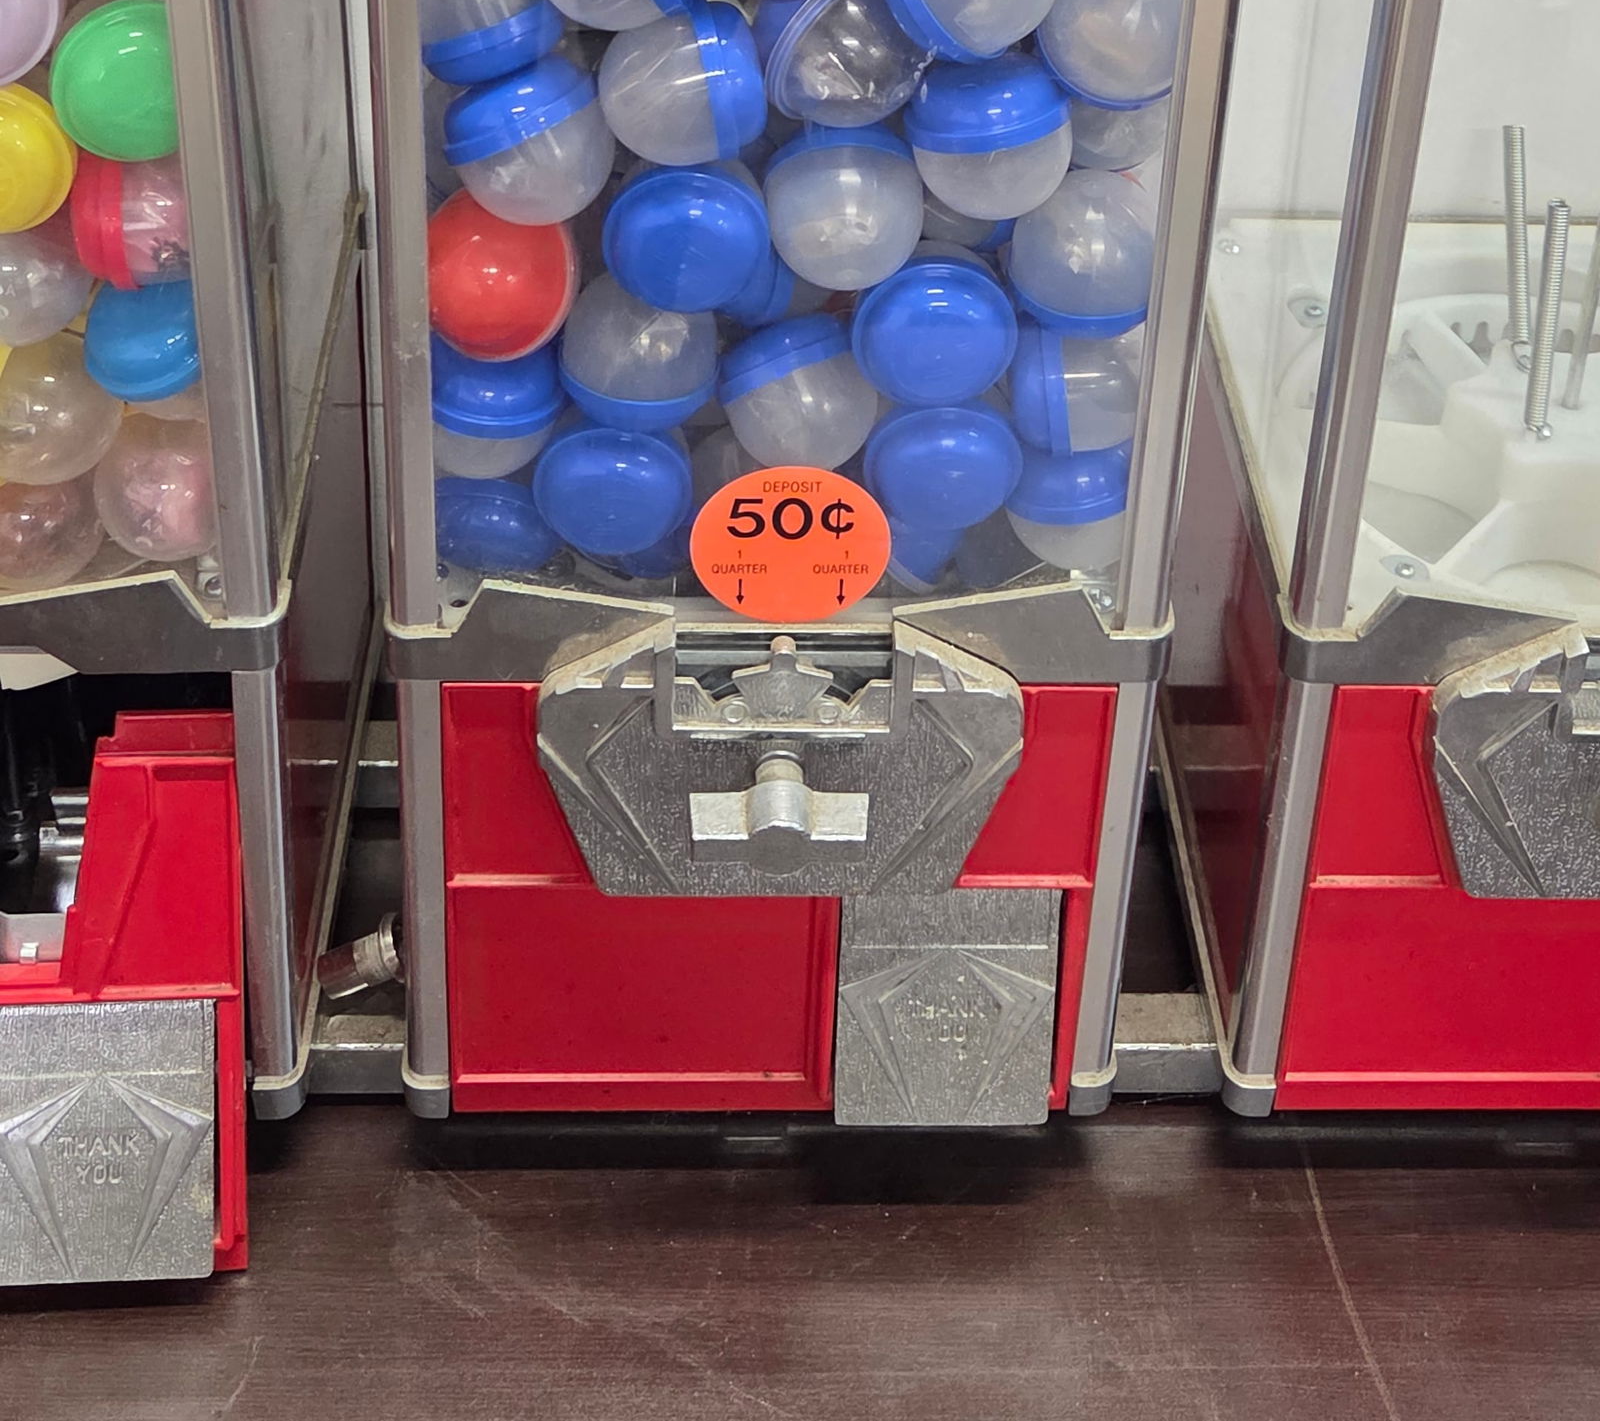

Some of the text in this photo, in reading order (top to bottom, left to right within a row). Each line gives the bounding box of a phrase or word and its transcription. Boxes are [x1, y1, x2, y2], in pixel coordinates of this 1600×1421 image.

[762, 481, 823, 493] DEPOSIT
[726, 497, 855, 540] 50¢
[737, 549, 743, 560] 1
[844, 549, 850, 560] 1
[711, 563, 768, 575] QUARTER
[812, 563, 870, 575] QUARTER
[57, 1131, 141, 1157] THANK
[75, 1164, 124, 1185] YOU
